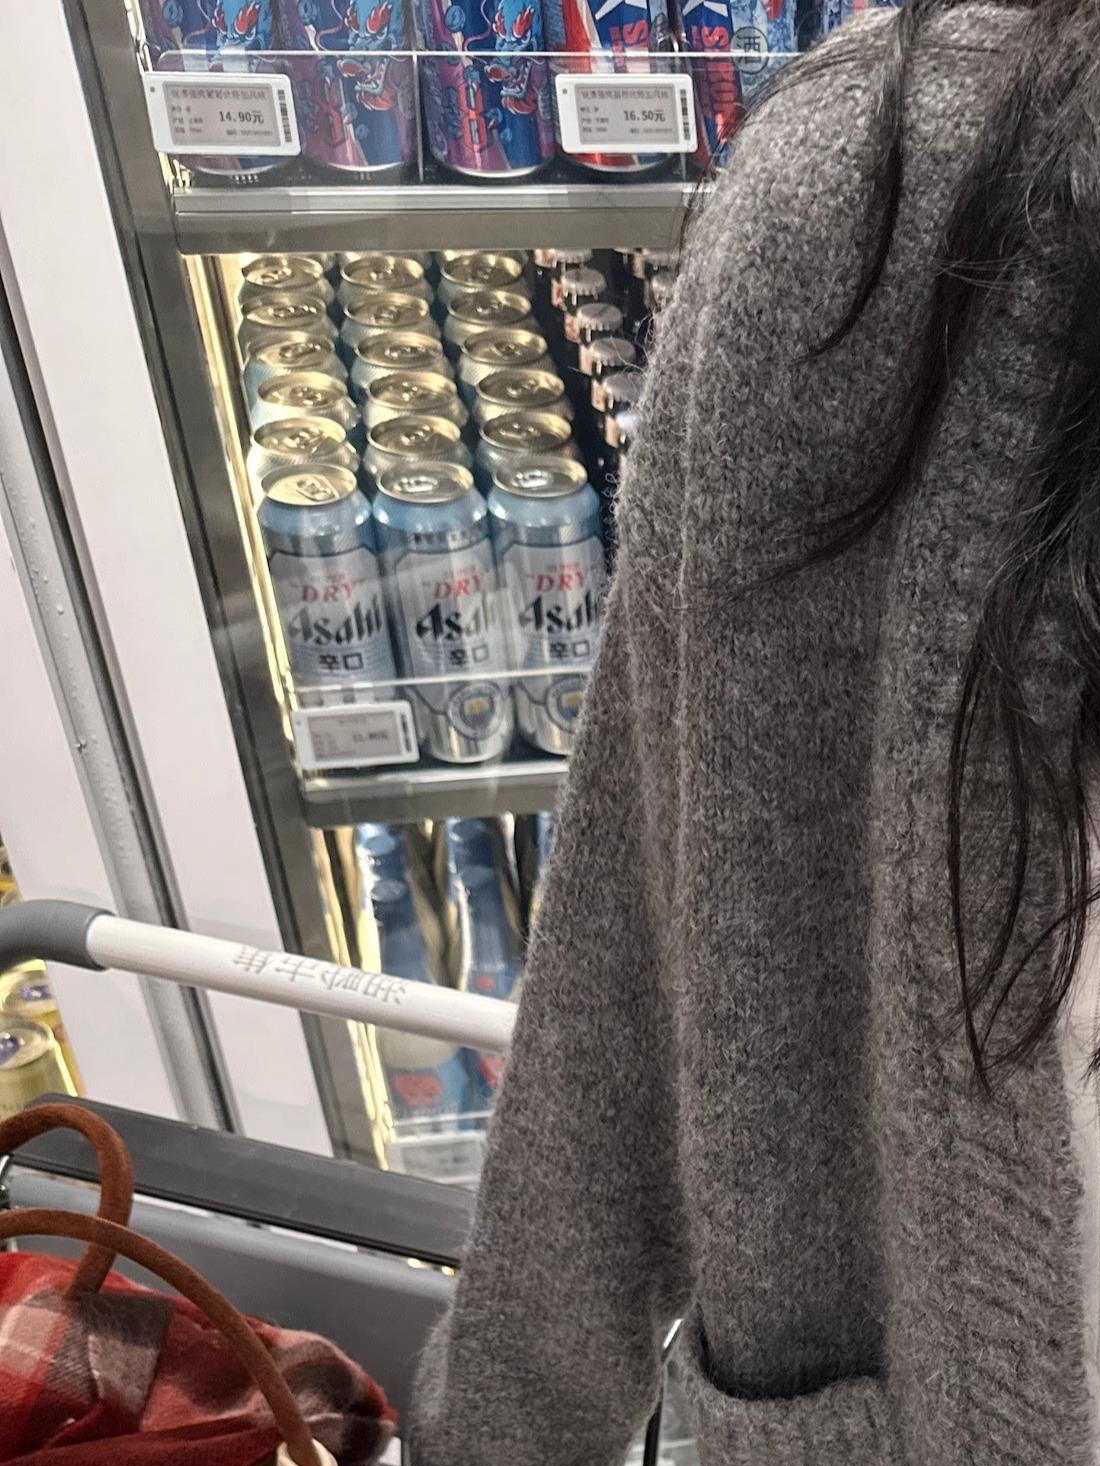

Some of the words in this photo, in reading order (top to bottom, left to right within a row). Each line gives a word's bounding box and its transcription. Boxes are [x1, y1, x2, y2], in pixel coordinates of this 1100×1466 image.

[736, 34, 761, 65] 酒
[219, 110, 265, 124] 14.90元
[624, 109, 666, 122] 16.50元
[287, 594, 382, 645] Asahi
[550, 640, 590, 659] 辛口
[319, 653, 364, 672] 辛口
